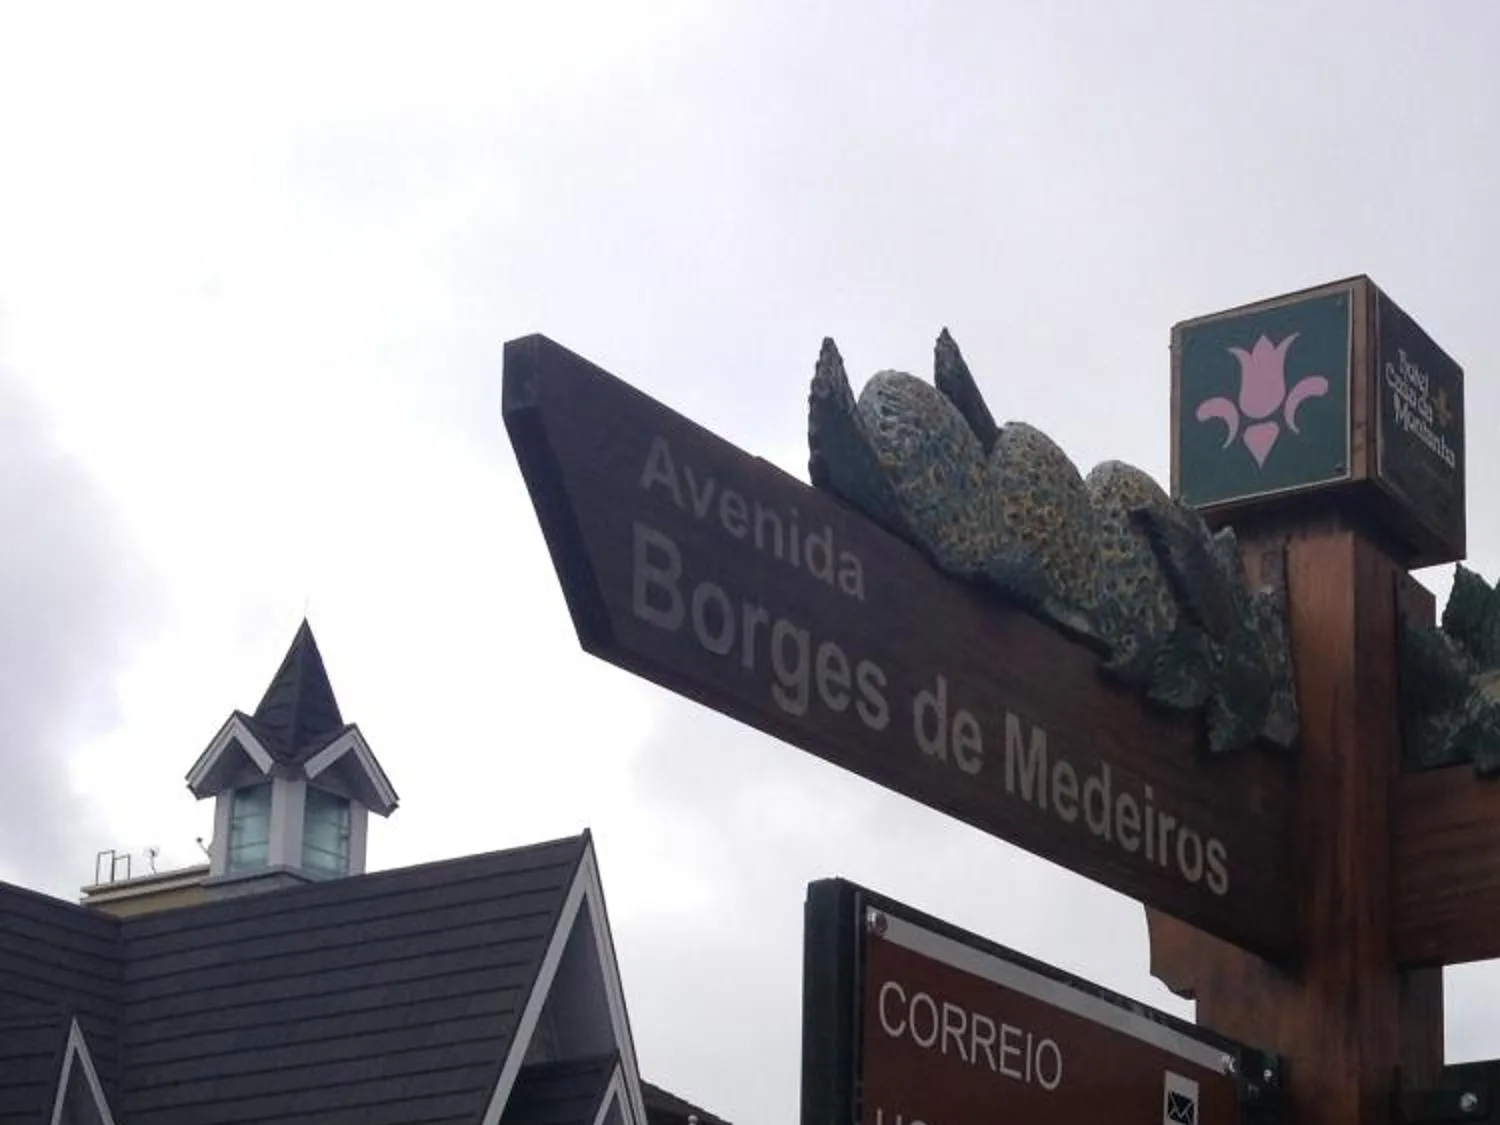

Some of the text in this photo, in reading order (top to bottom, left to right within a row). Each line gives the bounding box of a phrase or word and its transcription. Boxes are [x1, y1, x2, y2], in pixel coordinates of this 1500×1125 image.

[640, 436, 866, 601] Avenida
[630, 523, 1231, 897] Borges de Medeiros
[879, 981, 1062, 1090] CORREIO
